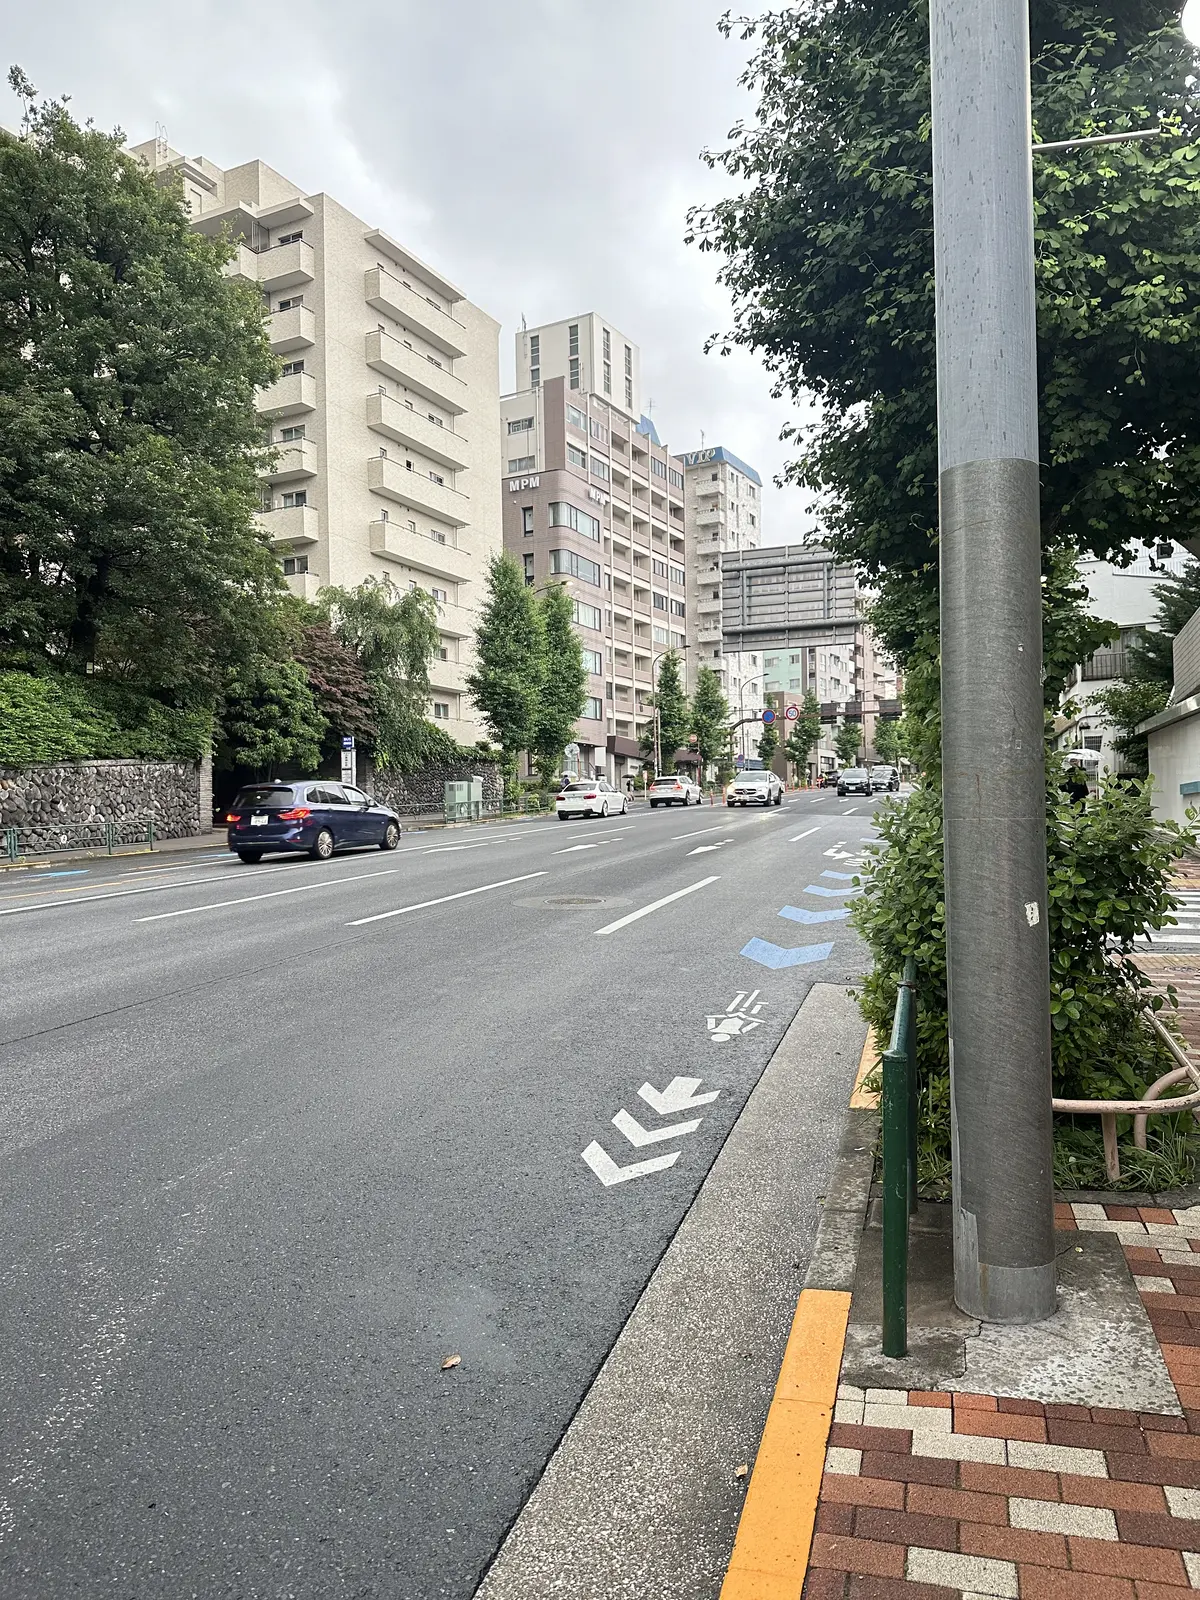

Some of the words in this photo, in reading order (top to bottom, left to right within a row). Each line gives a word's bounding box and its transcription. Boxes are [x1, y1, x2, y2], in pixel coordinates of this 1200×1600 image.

[686, 449, 715, 465] VIP
[509, 476, 540, 492] MPM
[589, 487, 610, 506] MPM
